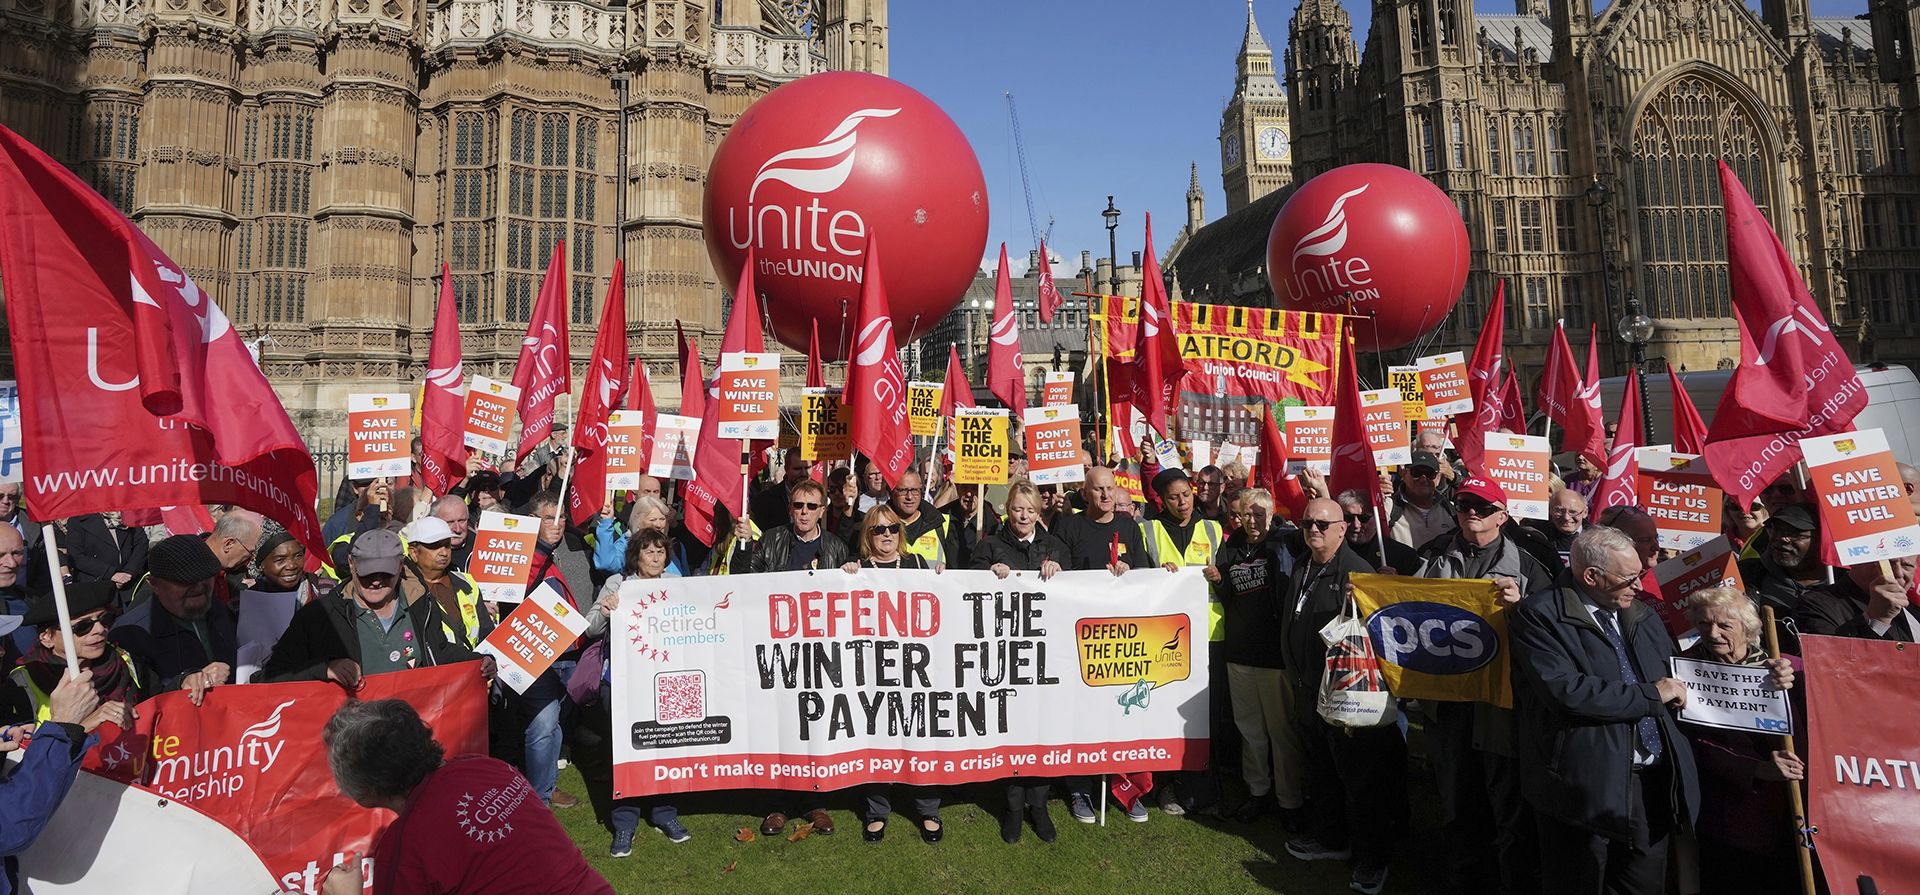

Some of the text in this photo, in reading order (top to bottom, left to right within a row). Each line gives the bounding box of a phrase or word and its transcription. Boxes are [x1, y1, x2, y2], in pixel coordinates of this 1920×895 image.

[730, 198, 865, 256] unite
[1284, 255, 1373, 301] unite
[1182, 336, 1294, 369] ATFORD
[1204, 362, 1280, 383] Union Council
[1392, 373, 1416, 382] TAX
[1430, 371, 1457, 381] SAVE
[733, 378, 766, 388] SAVE
[1425, 379, 1465, 391] WINTER
[724, 391, 774, 400] WINTER
[912, 388, 934, 398] TAX
[1402, 392, 1424, 402] ICH
[1434, 389, 1460, 399] FUEL
[476, 399, 507, 413] DON'T
[733, 404, 764, 413] FUEL
[808, 396, 839, 409] TAX
[911, 398, 932, 408] THE
[472, 408, 505, 423] LET US
[807, 410, 837, 422] THE
[911, 407, 939, 417] RICH
[1366, 411, 1391, 422] AVE
[363, 418, 398, 428] SAVE
[468, 417, 504, 434] FREEZE
[808, 422, 847, 435] RICH
[961, 418, 992, 430] TAX
[354, 430, 406, 440] WINTER
[607, 435, 629, 443] AVE
[665, 433, 691, 442] SAVE
[961, 431, 992, 444] THE
[1036, 429, 1070, 440] DON'T
[1369, 434, 1394, 444] UEL
[364, 443, 397, 453] FUEL
[607, 446, 636, 455] NTER
[962, 444, 1002, 457] RICH
[1036, 439, 1072, 450] LET US
[1293, 446, 1332, 454] FREEZE
[607, 458, 626, 466] UEL
[663, 452, 687, 460] FUEL
[1035, 450, 1075, 461] FREEZE
[1498, 458, 1534, 469] SAVE
[1490, 468, 1544, 482] WINTER
[1832, 468, 1882, 488] SAVE
[1499, 482, 1533, 493] FUEL
[1653, 479, 1706, 495] DON'T
[1651, 494, 1708, 509] LET US
[1826, 485, 1900, 507] WINTER
[1647, 506, 1710, 523] FREEZE
[1846, 506, 1894, 524] FUEL
[488, 538, 522, 551] SAVE
[1848, 545, 1870, 557] NPC
[477, 550, 528, 565] WINTER
[484, 564, 515, 576] FUEL
[1678, 568, 1721, 593] SAVE
[663, 604, 697, 617] unite
[768, 590, 1046, 639] DEFEND THE
[527, 613, 559, 643] SAVE
[648, 613, 716, 634] Retired
[1081, 623, 1138, 640] DEFEND
[510, 617, 555, 660] WINTER
[663, 632, 725, 646] members
[1380, 615, 1484, 666] pcs
[506, 635, 536, 664] FUEL
[1084, 642, 1147, 659] THE FUEL
[1155, 650, 1182, 664] unite
[755, 639, 1059, 690] WINTER FUEL
[1087, 660, 1152, 679] PAYMENT
[1694, 668, 1762, 683] SAVE THE
[1684, 681, 1779, 700] WINTER FUEL
[1697, 697, 1768, 713] PAYMENT
[798, 688, 1017, 741] PAYMENT
[654, 725, 678, 733] campaign
[1755, 717, 1788, 731] NPC
[650, 732, 671, 740] payment
[653, 745, 1172, 782] Don't make pensioners pay for a crisis we did not create.
[477, 788, 499, 808] unite
